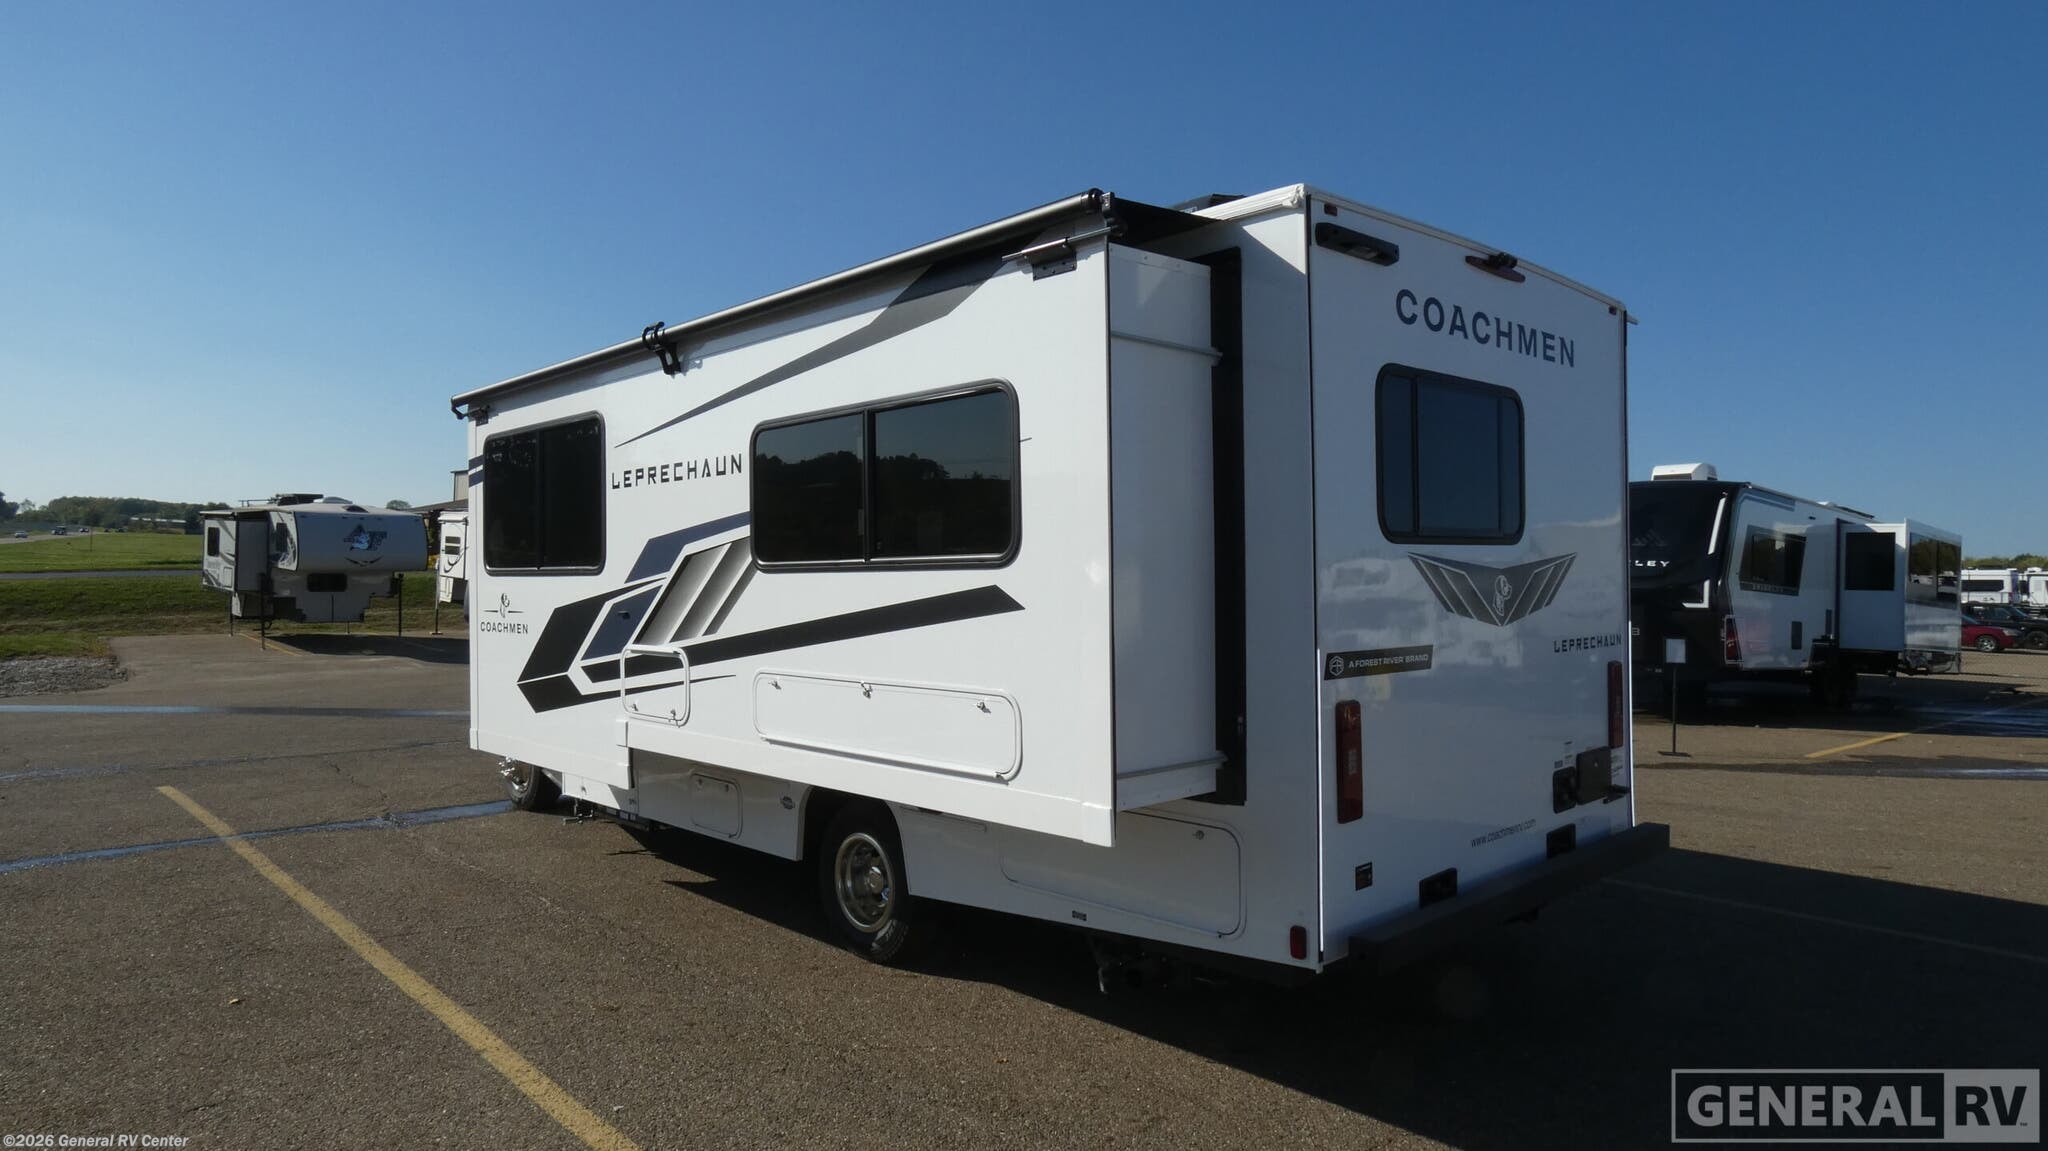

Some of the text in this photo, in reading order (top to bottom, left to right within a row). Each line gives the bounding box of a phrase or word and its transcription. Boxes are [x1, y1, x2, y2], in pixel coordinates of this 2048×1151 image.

[1395, 289, 1575, 368] COACHMEN
[611, 453, 742, 490] LEPRECHAUN
[480, 621, 529, 634] COACHMEN
[1553, 633, 1622, 653] LEPRECHAUN
[1348, 653, 1429, 669] A FOREST RIVER BRAND
